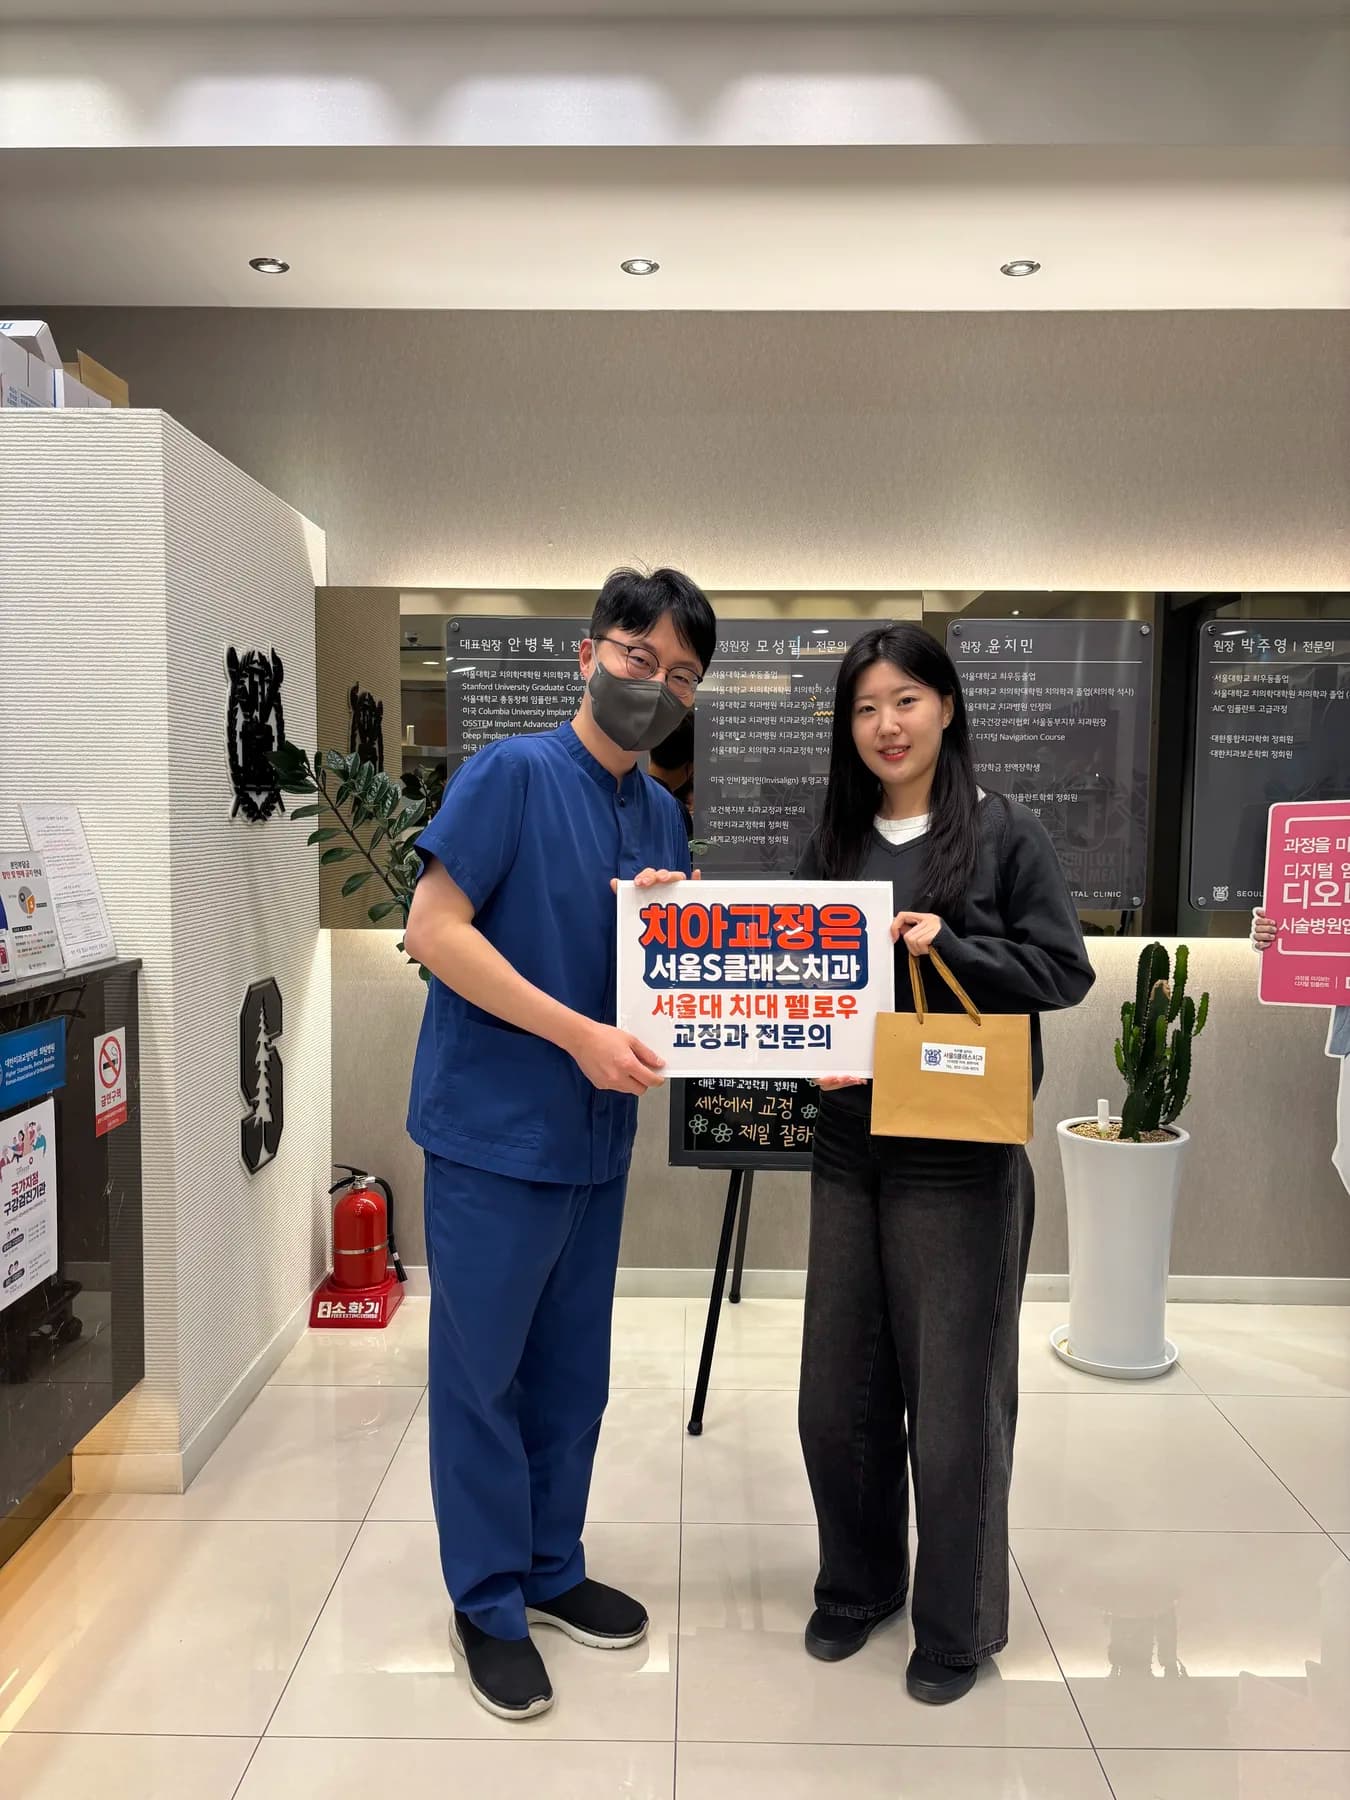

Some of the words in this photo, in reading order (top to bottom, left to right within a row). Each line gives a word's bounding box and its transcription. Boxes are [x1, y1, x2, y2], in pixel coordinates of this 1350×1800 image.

[459, 638, 502, 652] 대표원장
[714, 640, 750, 653] 정원장
[816, 640, 848, 652] 전문의
[959, 640, 982, 654] 원장
[1212, 640, 1235, 653] 원장
[1302, 640, 1335, 653] 전문의
[462, 670, 497, 680] 서울대학교
[542, 671, 571, 681] 치의학과
[711, 670, 747, 680] 서울대학교
[961, 672, 998, 681] 서울대학교
[1213, 674, 1250, 684] 서울대학교
[462, 682, 493, 691] Stanford
[494, 683, 530, 692] University
[531, 683, 565, 692] Graduate
[711, 685, 747, 695] 서울대학교
[1044, 687, 1074, 697] 치의학과
[462, 695, 498, 704] 서울대학교
[1213, 689, 1250, 699] 서울대학교
[1297, 690, 1327, 700] 치의학과
[711, 701, 747, 710] 서울대학교
[749, 701, 777, 710] 치과병원
[779, 701, 815, 711] 치과교정과
[998, 702, 1028, 712] 치과병원
[1212, 704, 1225, 712] AIC
[1227, 704, 1256, 714] 임플란트
[1258, 704, 1288, 714] 고급과정
[462, 707, 477, 716] 미국
[478, 708, 510, 716] Columbia
[511, 708, 545, 717] University
[546, 708, 572, 718] Implant
[462, 719, 493, 728] OSSTEM
[494, 720, 522, 730] Implant
[522, 721, 558, 729] Advanced
[711, 716, 747, 725] 서울대학교
[748, 716, 777, 725] 치과병원
[779, 716, 814, 726] 치과교정과
[1077, 718, 1107, 727] 치과원장
[462, 731, 481, 741] Deep
[711, 731, 746, 740] 서울대학교
[748, 731, 777, 741] 치과병원
[778, 731, 814, 741] 치과교정과
[976, 733, 998, 742] 디지털
[999, 733, 1039, 742] Navigation
[1040, 733, 1066, 741] Course
[1271, 735, 1294, 745] 정회원
[711, 746, 746, 755] 서울대학교
[1271, 750, 1294, 760] 정회원
[710, 775, 725, 785] 미국
[1055, 793, 1078, 803] 정회원
[709, 806, 746, 815] 보건복지부
[747, 806, 782, 815] 치과교정과
[784, 806, 806, 815] 전문의
[709, 820, 766, 830] 대한치과교정학회
[768, 820, 789, 830] 정회원
[767, 835, 789, 845] 정회원
[1283, 836, 1331, 854] 과정을
[1283, 862, 1334, 880] 디지털
[1093, 890, 1122, 898] CLINIC
[1236, 890, 1264, 898] SEOUL
[640, 904, 862, 950] 치아교정은
[649, 953, 860, 983] 서울S클래스치과
[652, 993, 722, 1020] 서울대
[729, 993, 778, 1020] 치대
[784, 993, 858, 1020] 펠로우
[673, 1023, 749, 1049] 교정과
[755, 1023, 832, 1050] 전문의
[698, 1078, 716, 1090] 대한
[718, 1078, 736, 1088] 치과
[736, 1079, 769, 1091] 교정학회
[100, 1087, 122, 1108] 금연구역
[694, 1094, 753, 1115] 세상에서
[758, 1096, 793, 1120] 교정
[738, 1123, 771, 1146] 제일
[779, 1123, 815, 1147] 잘하
[11, 1170, 40, 1196] 국가지정
[331, 1300, 380, 1314] 소화기
